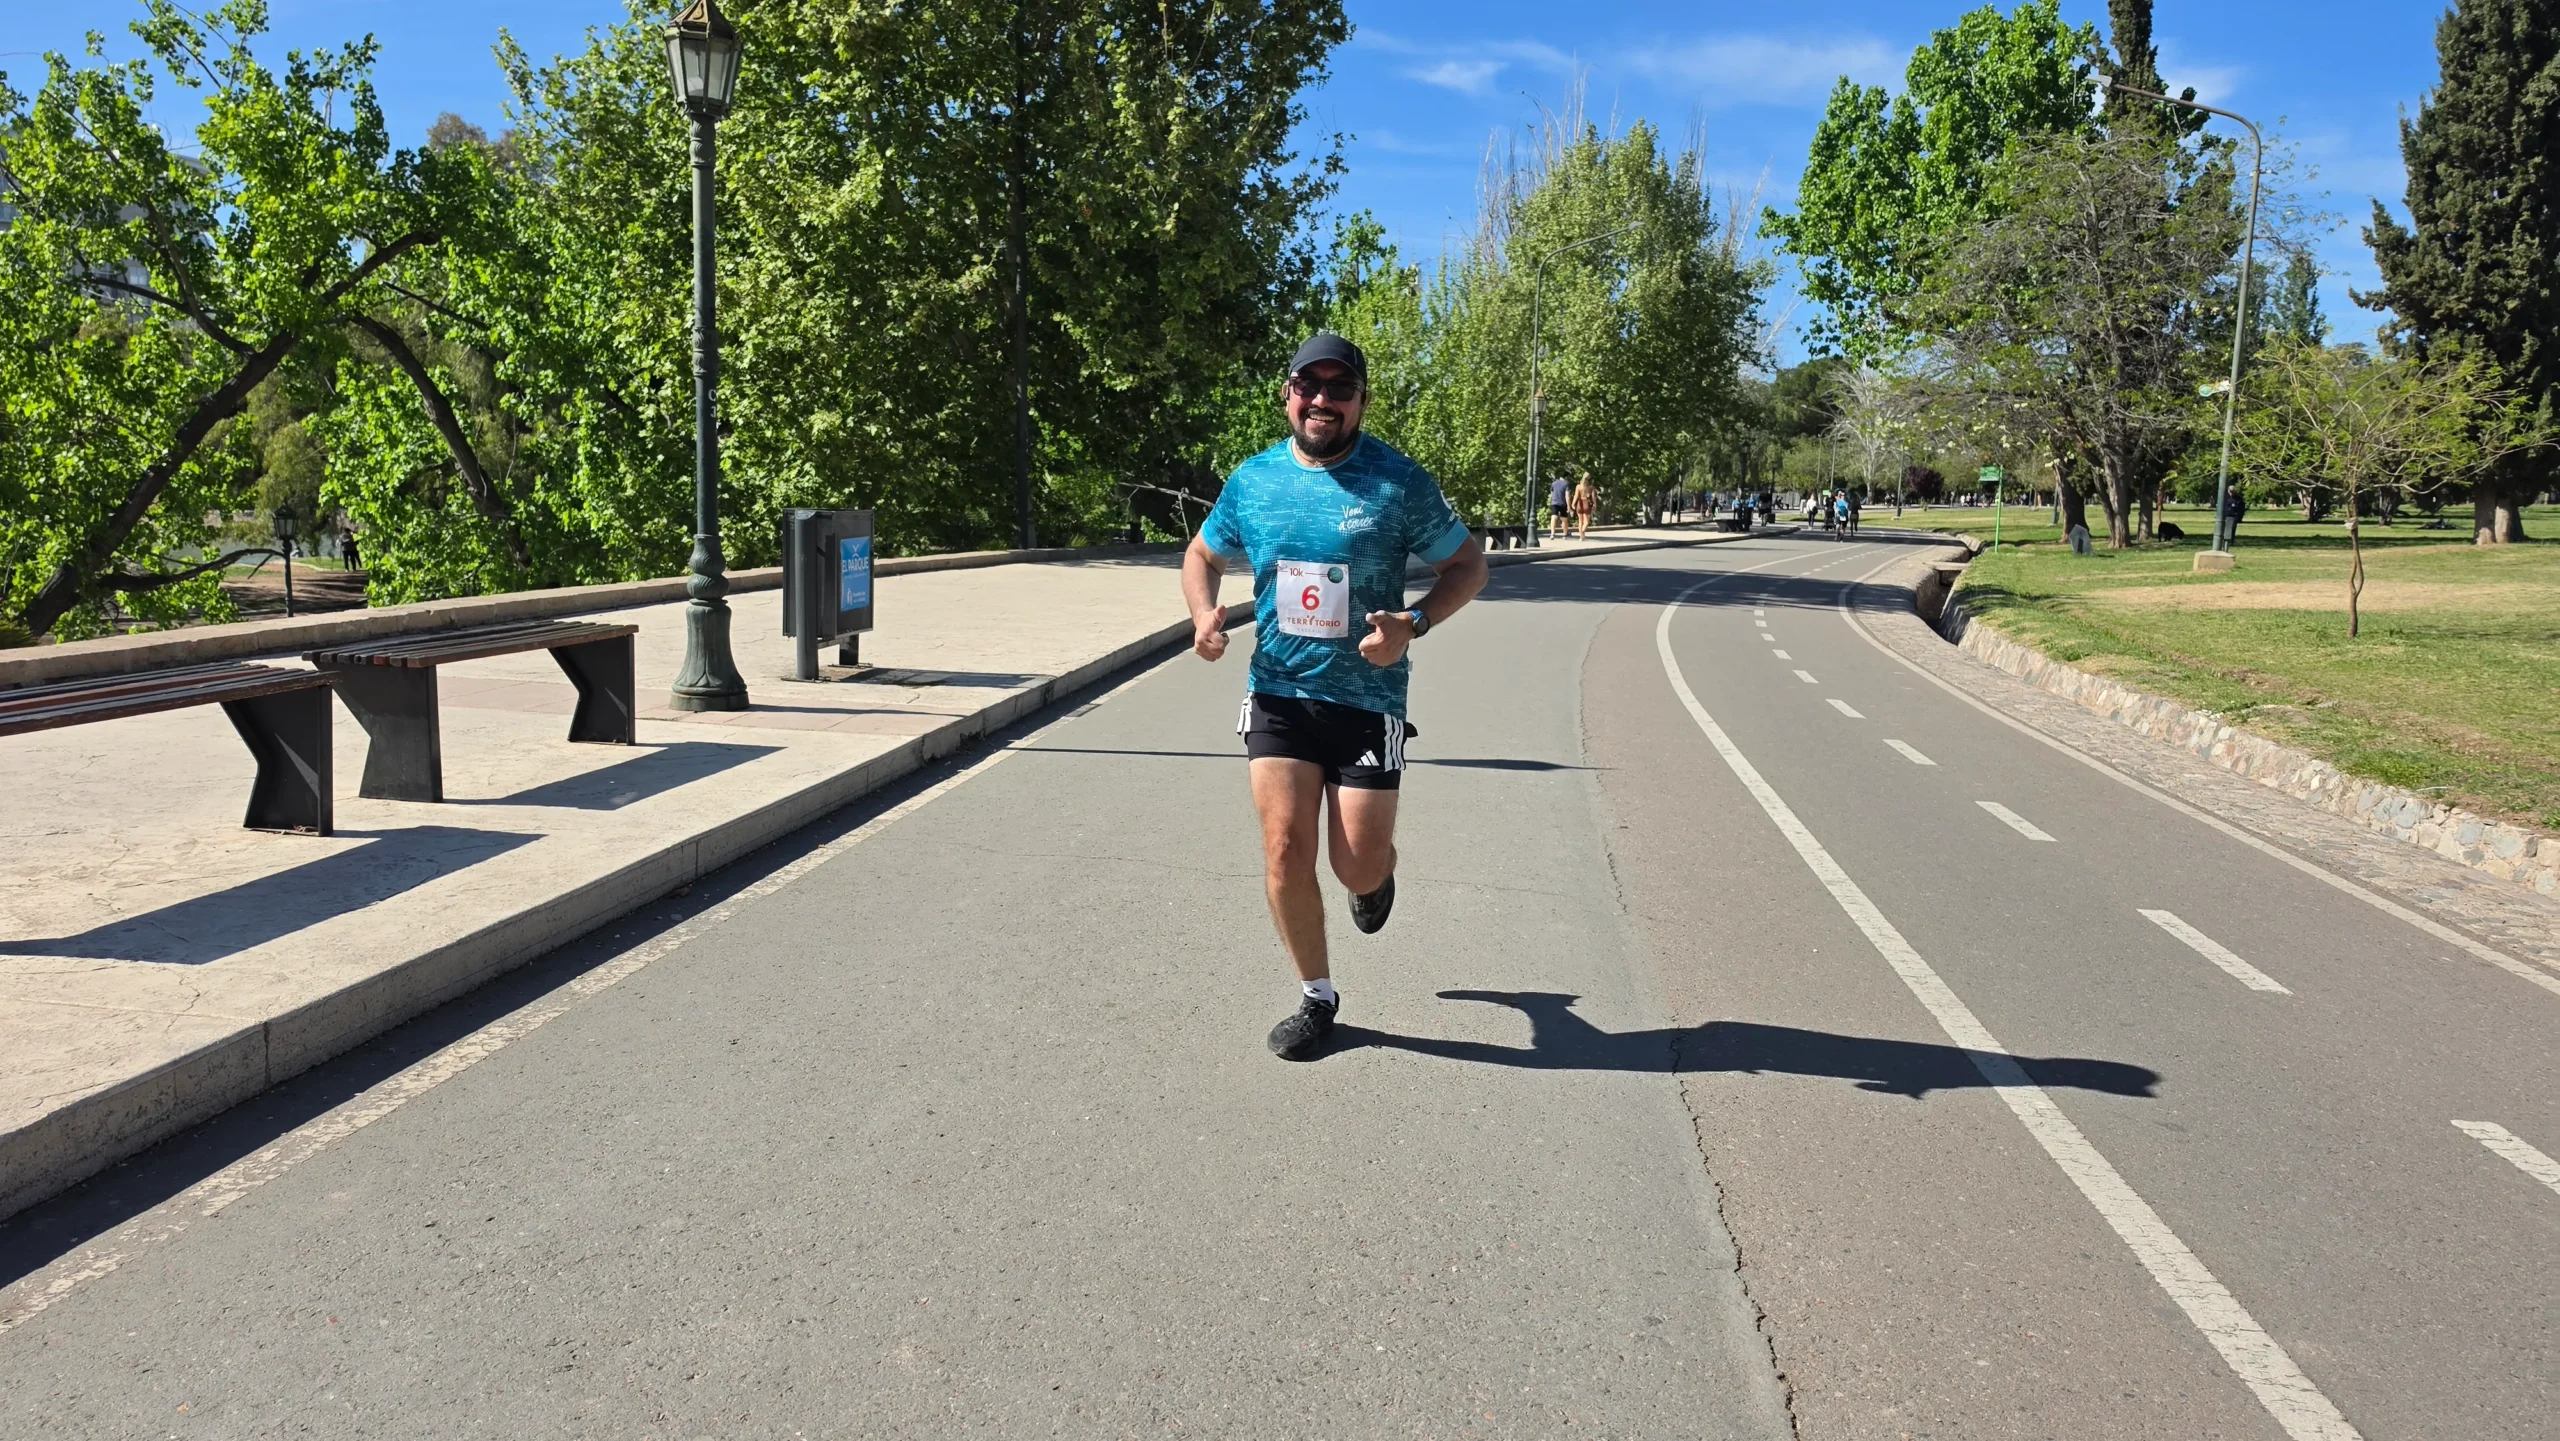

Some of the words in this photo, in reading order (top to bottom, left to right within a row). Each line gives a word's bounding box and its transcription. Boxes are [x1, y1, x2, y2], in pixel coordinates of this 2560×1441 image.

[842, 560, 847, 572] EL
[848, 556, 869, 571] PARQUE
[1289, 567, 1303, 577] 10k
[1301, 585, 1320, 611] 6
